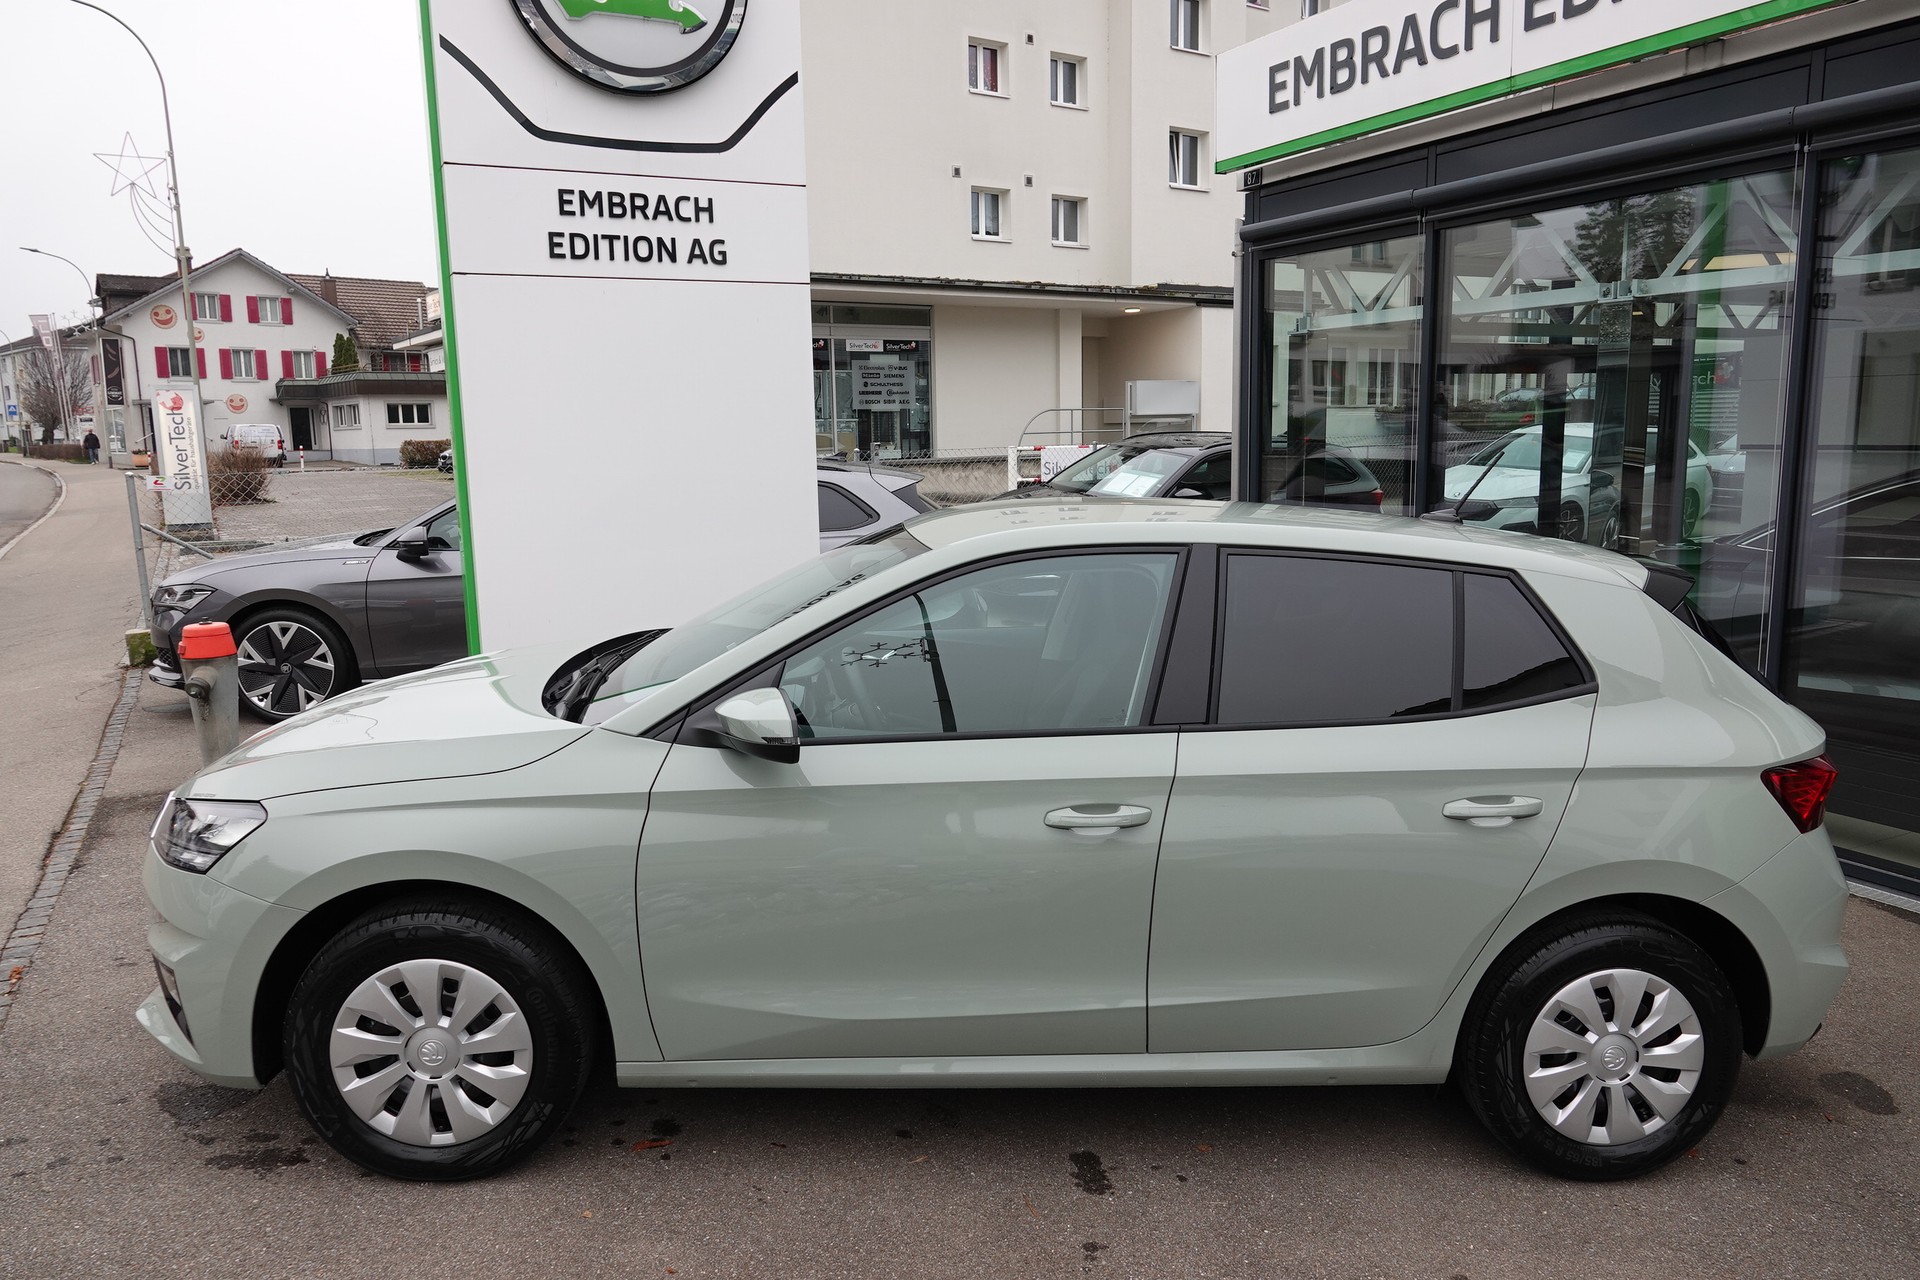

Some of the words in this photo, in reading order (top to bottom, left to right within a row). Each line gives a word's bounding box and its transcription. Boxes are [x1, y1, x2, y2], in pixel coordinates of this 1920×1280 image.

[1268, 0, 1501, 115] EMBRACH
[1247, 171, 1257, 185] 87
[558, 188, 715, 224] EMBRACH
[548, 231, 678, 264] EDITION
[686, 238, 728, 266] AG
[166, 408, 186, 446] Tech
[173, 444, 192, 490] Silver
[1043, 461, 1067, 476] Silv
